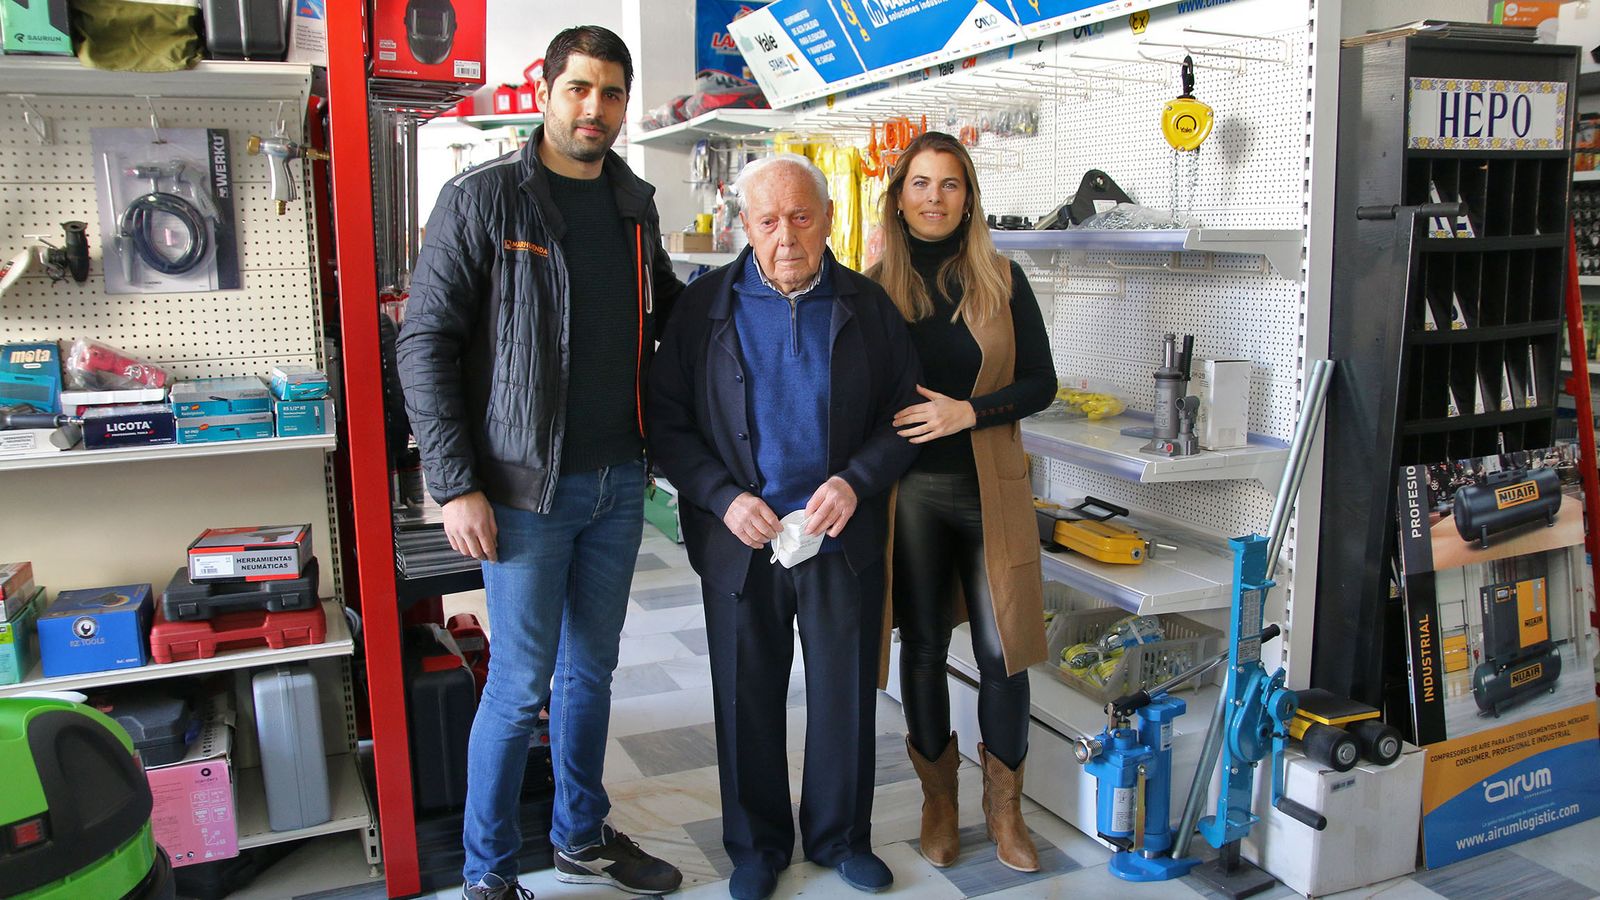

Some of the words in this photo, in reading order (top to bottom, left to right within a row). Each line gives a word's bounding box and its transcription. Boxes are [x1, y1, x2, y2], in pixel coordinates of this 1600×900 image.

[754, 32, 778, 53] Yale
[938, 62, 955, 77] Yale
[1439, 92, 1532, 138] HEPO
[213, 135, 228, 187] WERKU
[10, 349, 51, 364] mota
[106, 421, 152, 432] LICOTA
[1406, 465, 1422, 539] PROFESIO
[1499, 484, 1536, 503] NUAIR
[1419, 614, 1435, 703] INDUSTRIAL
[1511, 666, 1541, 684] NUAIR
[1430, 746, 1470, 762] COMPRESORES
[1479, 741, 1490, 750] AIRE
[1491, 738, 1505, 746] PARA
[1506, 735, 1515, 743] LOS
[1527, 723, 1557, 736] SEGMENTOS
[1557, 720, 1567, 728] DEL
[1568, 714, 1589, 724] MERCADO
[1455, 751, 1491, 767] CONSUMER,
[1492, 740, 1530, 758] PROFESIONAL
[1536, 730, 1571, 744] INDUSTRIAL
[1483, 767, 1552, 803] airum
[1456, 803, 1580, 850] www.airumlogistic.com
